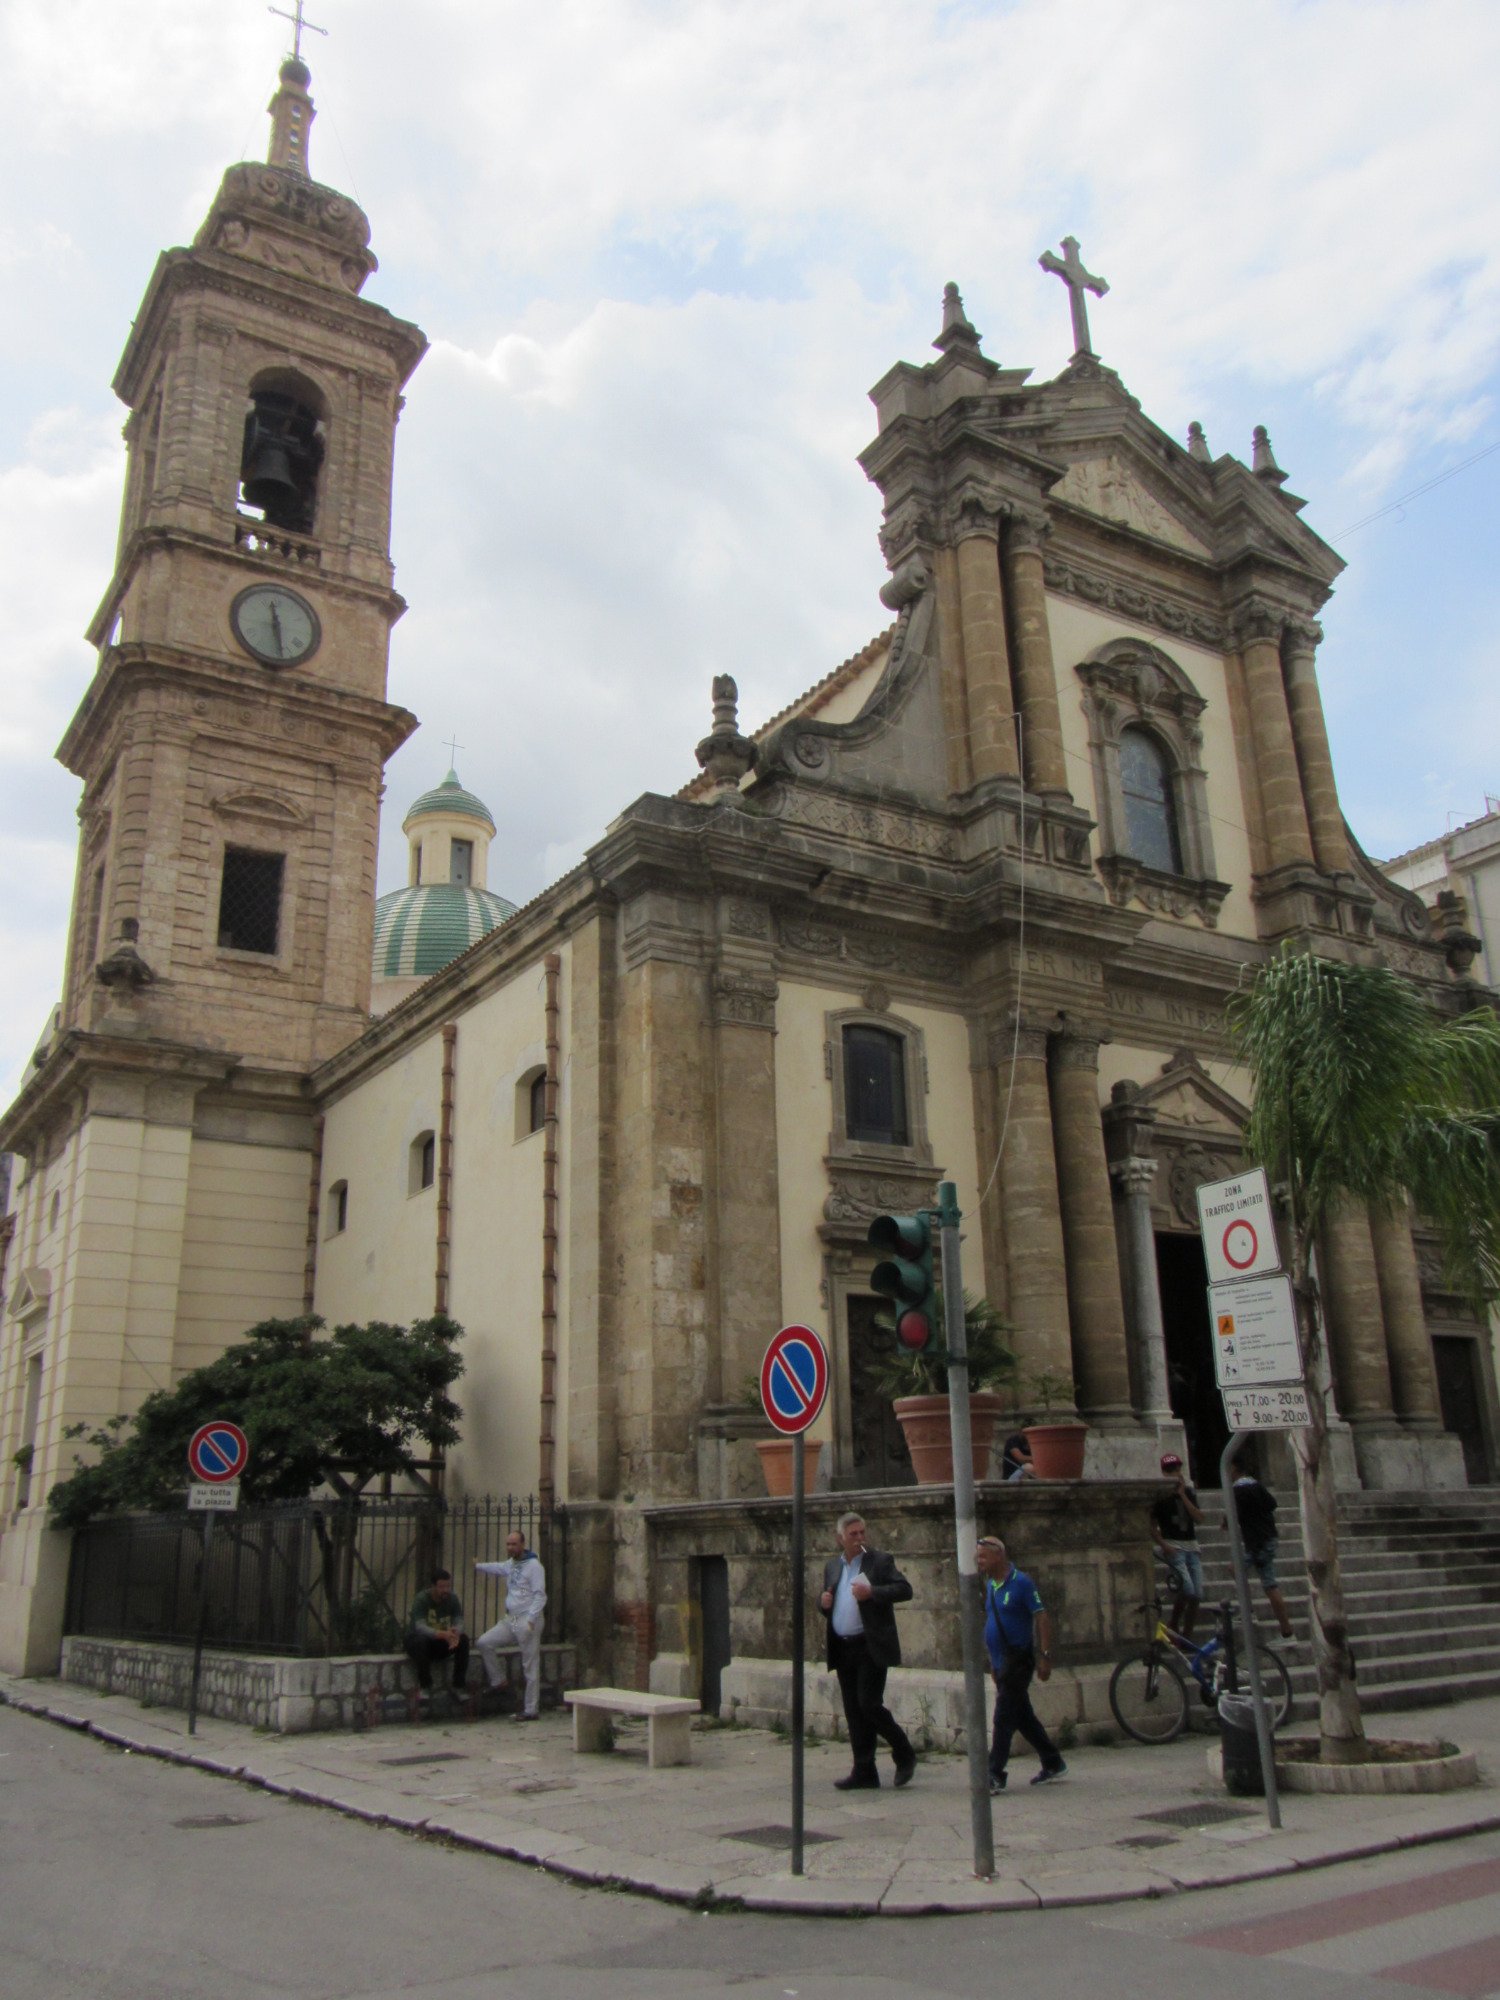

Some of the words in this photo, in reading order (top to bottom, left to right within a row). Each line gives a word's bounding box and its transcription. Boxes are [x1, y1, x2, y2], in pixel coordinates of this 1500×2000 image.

[1071, 959, 1103, 984] ME
[1224, 1184, 1242, 1197] ZONA
[1204, 1202, 1235, 1218] TRAFFICO
[1236, 1193, 1263, 1210] LIMITATO
[1253, 1411, 1273, 1424] 9.00
[1281, 1410, 1308, 1423] 20.00
[205, 1498, 231, 1506] piazza
